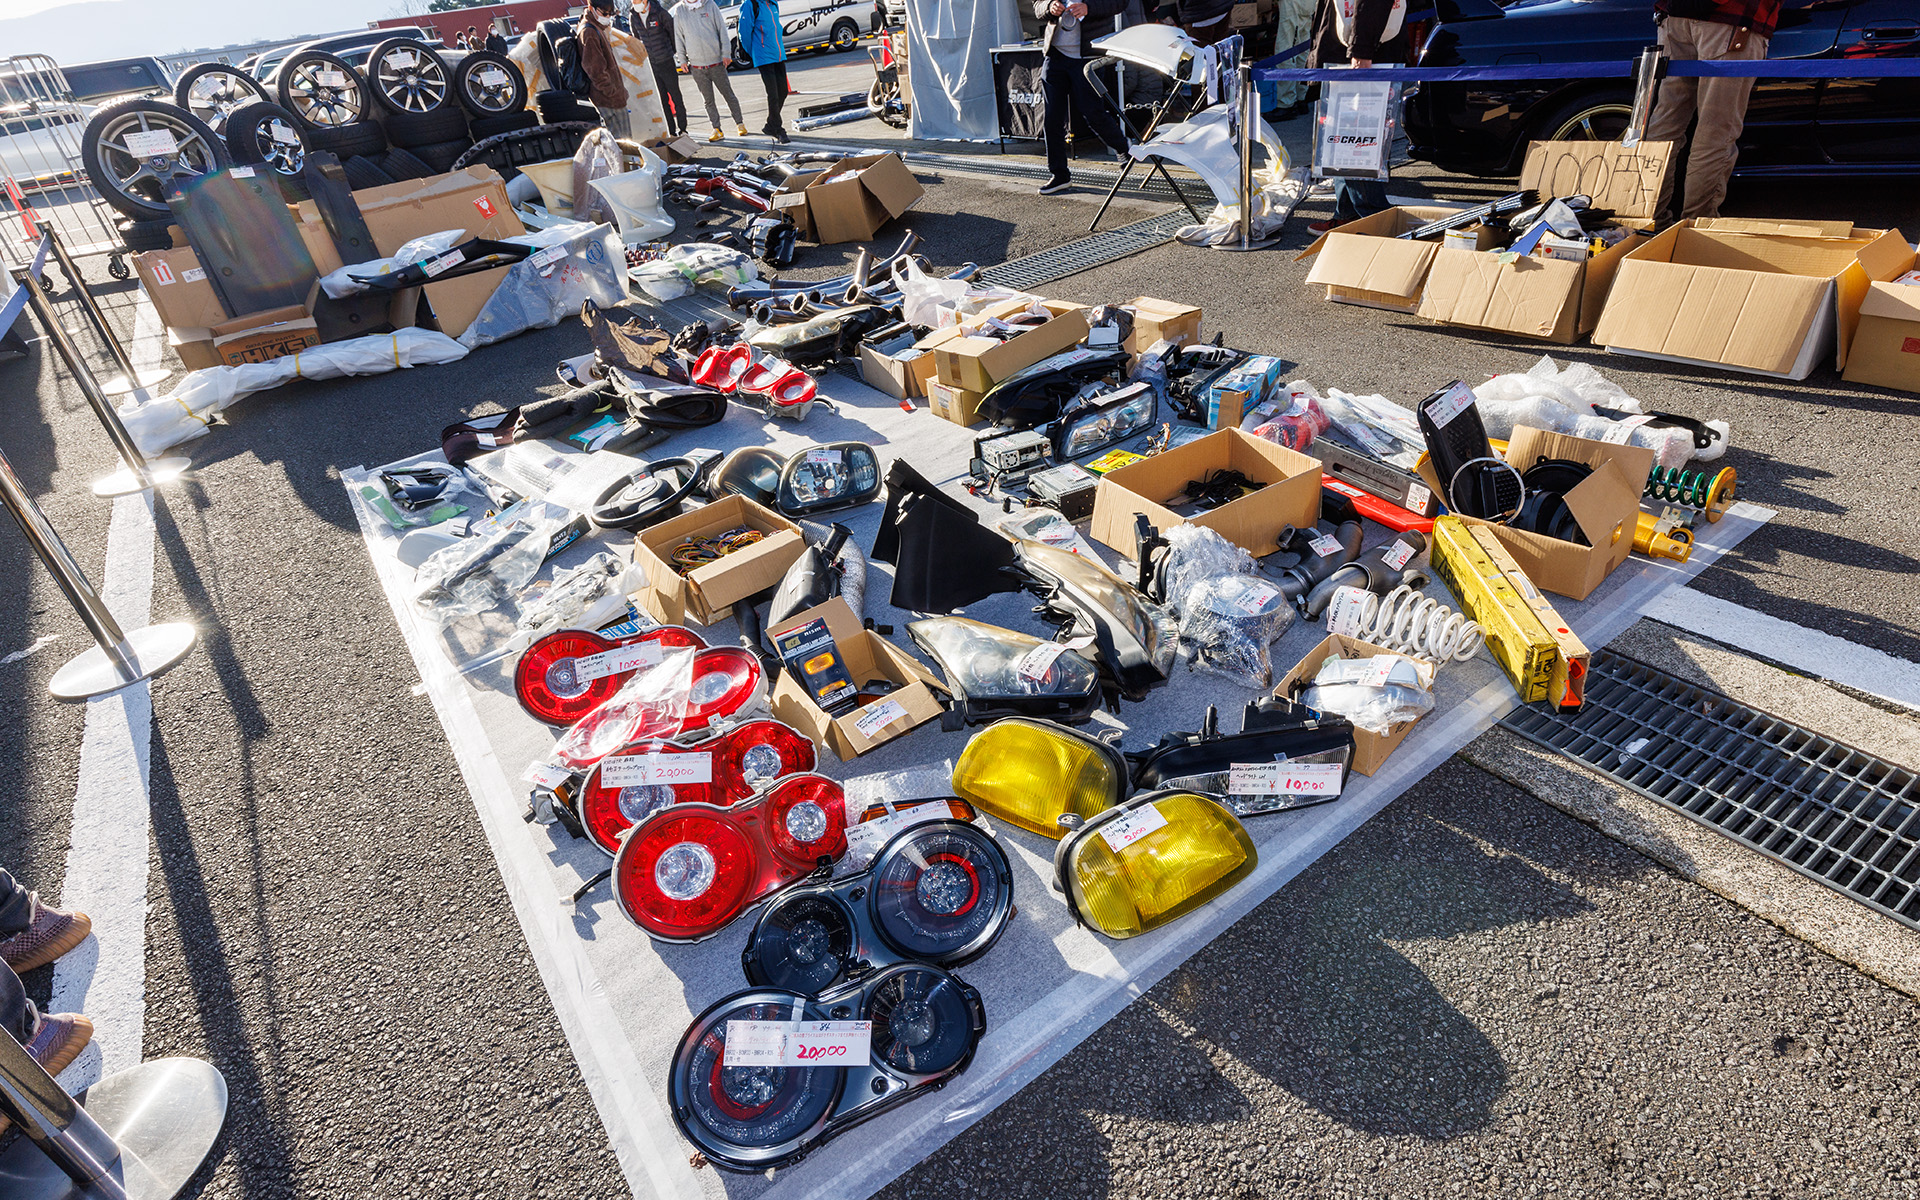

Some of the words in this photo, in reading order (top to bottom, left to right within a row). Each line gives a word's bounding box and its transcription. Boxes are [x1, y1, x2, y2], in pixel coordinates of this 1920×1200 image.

[1340, 135, 1377, 144] CRAFT
[241, 337, 308, 364] HKS
[655, 768, 695, 779] 20,000
[1285, 778, 1325, 792] 10,000
[796, 1043, 848, 1062] 20,000
